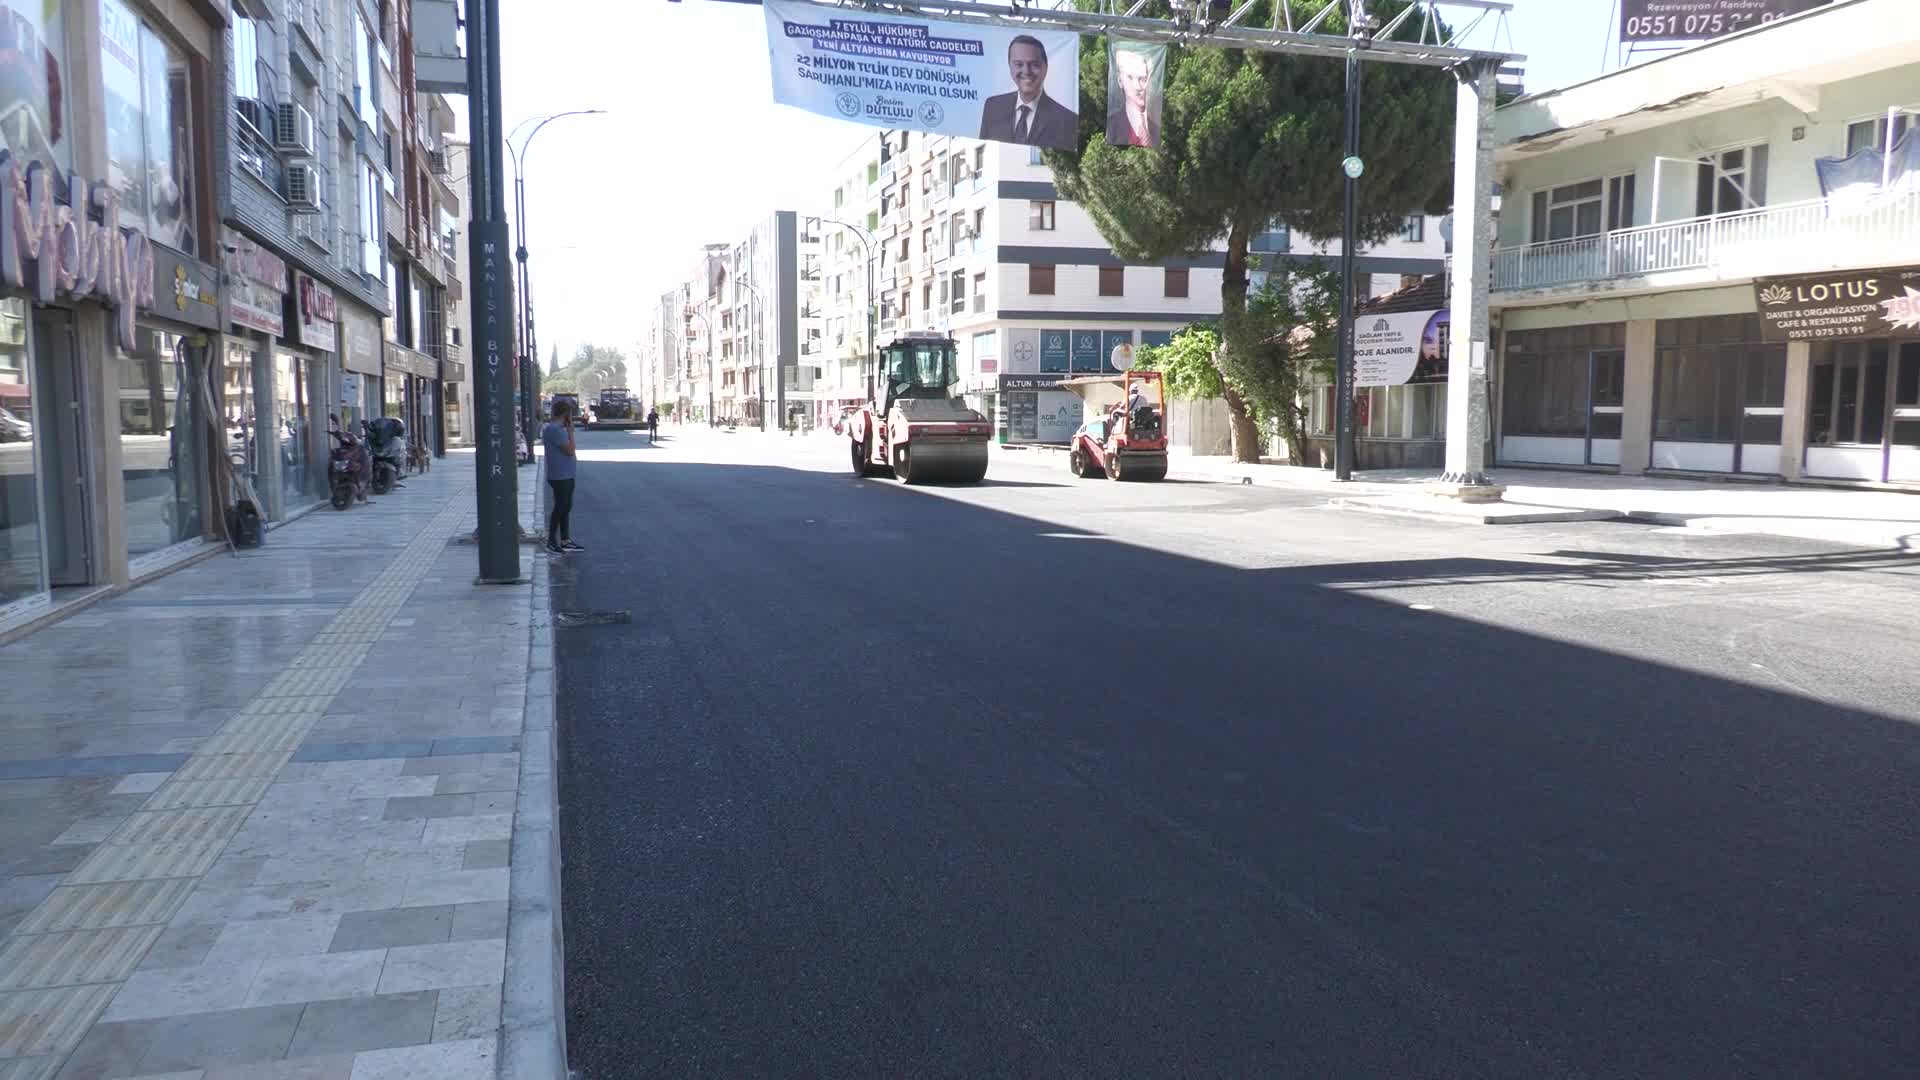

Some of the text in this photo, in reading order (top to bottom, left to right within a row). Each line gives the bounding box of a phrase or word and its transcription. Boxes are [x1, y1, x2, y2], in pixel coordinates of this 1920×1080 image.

[1647, 2, 1711, 13] Rezervasyon
[1720, 0, 1766, 10] Randevu
[835, 22, 926, 39] 7 EYLÜL, HÜKÜMET,
[1627, 16, 1677, 36] 0551
[1684, 14, 1724, 34] 075
[817, 39, 951, 65] YENİ ALTYAPISINA KAVUŞUYOR
[871, 35, 883, 44] VE
[885, 36, 927, 49] ATATÜRK
[929, 40, 980, 53] CADDELERİ
[813, 53, 855, 71] MİLYON
[892, 66, 913, 79] DEV
[915, 67, 971, 86] DÖNÜŞÜM
[798, 67, 978, 100] SARUHANLI'MIZA HAYIRLI OLSUN!
[866, 104, 914, 118] DUTLULU
[1797, 279, 1879, 302] LOTUS
[1766, 304, 1877, 319] DAVET & ORGANİZASYON
[1777, 315, 1867, 328] CAFE & RESTAURANT
[1789, 326, 1864, 338] 0551 075 31 91
[1353, 349, 1374, 357] ROJE
[1006, 380, 1032, 388] ALTUN
